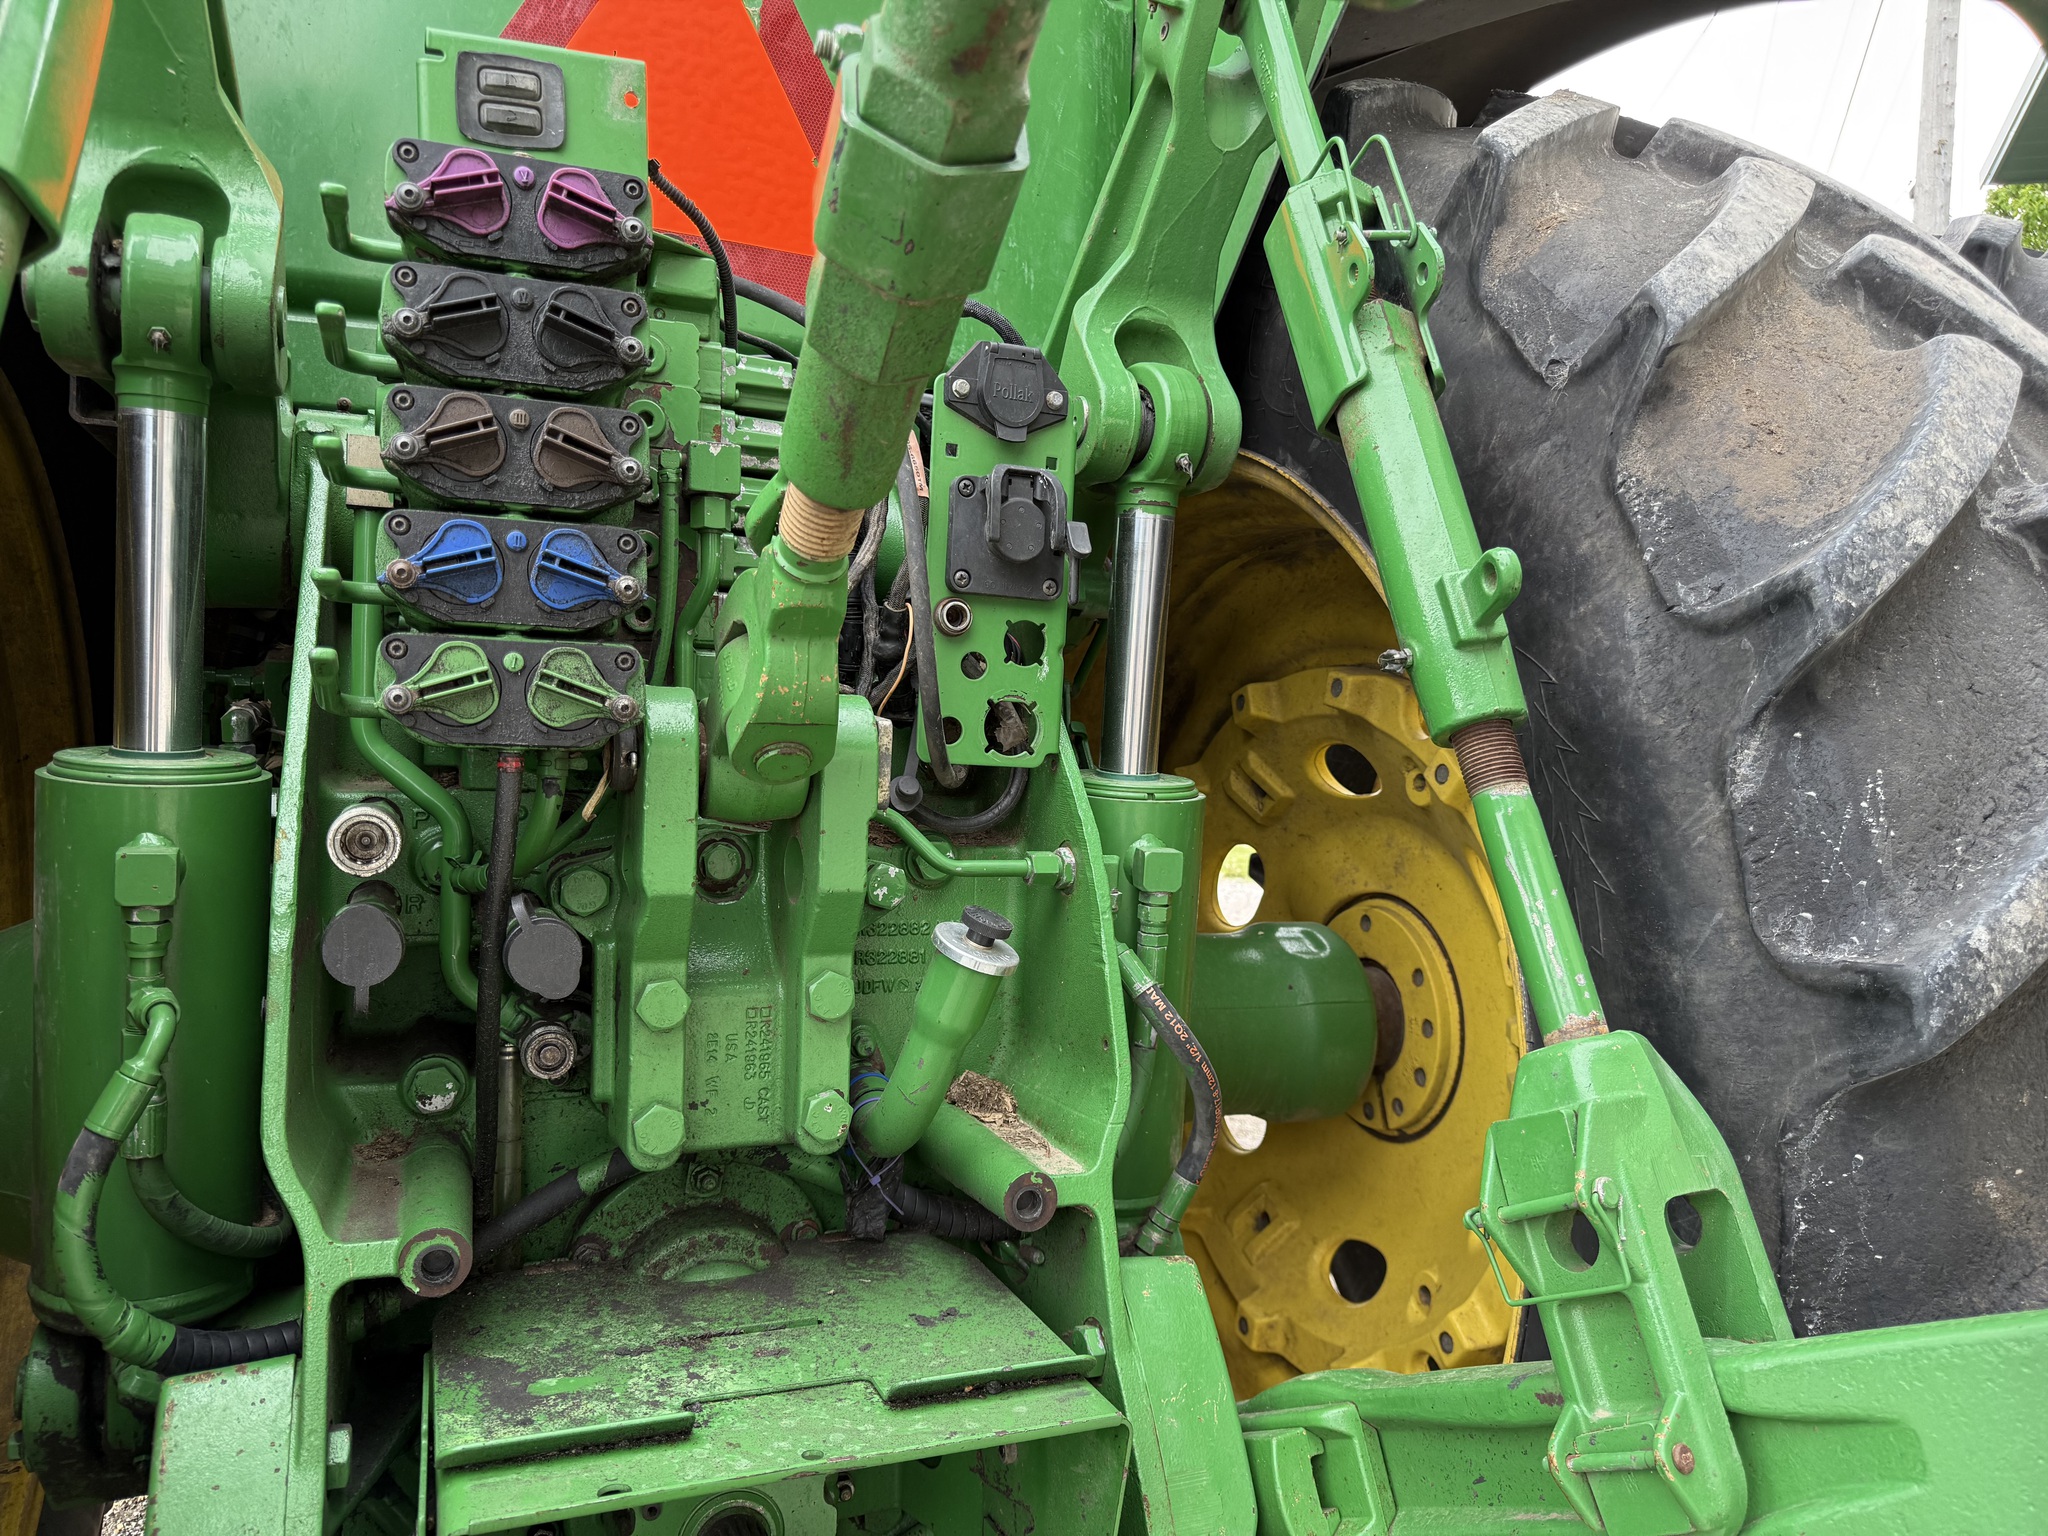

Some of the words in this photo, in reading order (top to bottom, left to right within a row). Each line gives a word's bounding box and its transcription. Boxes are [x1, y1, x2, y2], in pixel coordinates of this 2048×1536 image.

[992, 381, 1034, 403] Pollak
[412, 810, 431, 830] P
[405, 893, 424, 914] R
[854, 949, 926, 966] RS22881
[1164, 1010, 1189, 1041] 2Q12
[725, 1033, 739, 1063] USA
[743, 1020, 758, 1081] R241963
[758, 1019, 772, 1080] R241965
[1186, 1043, 1202, 1062] 1/2"
[1201, 1061, 1217, 1090] 12mm
[757, 1087, 771, 1122] CAST
